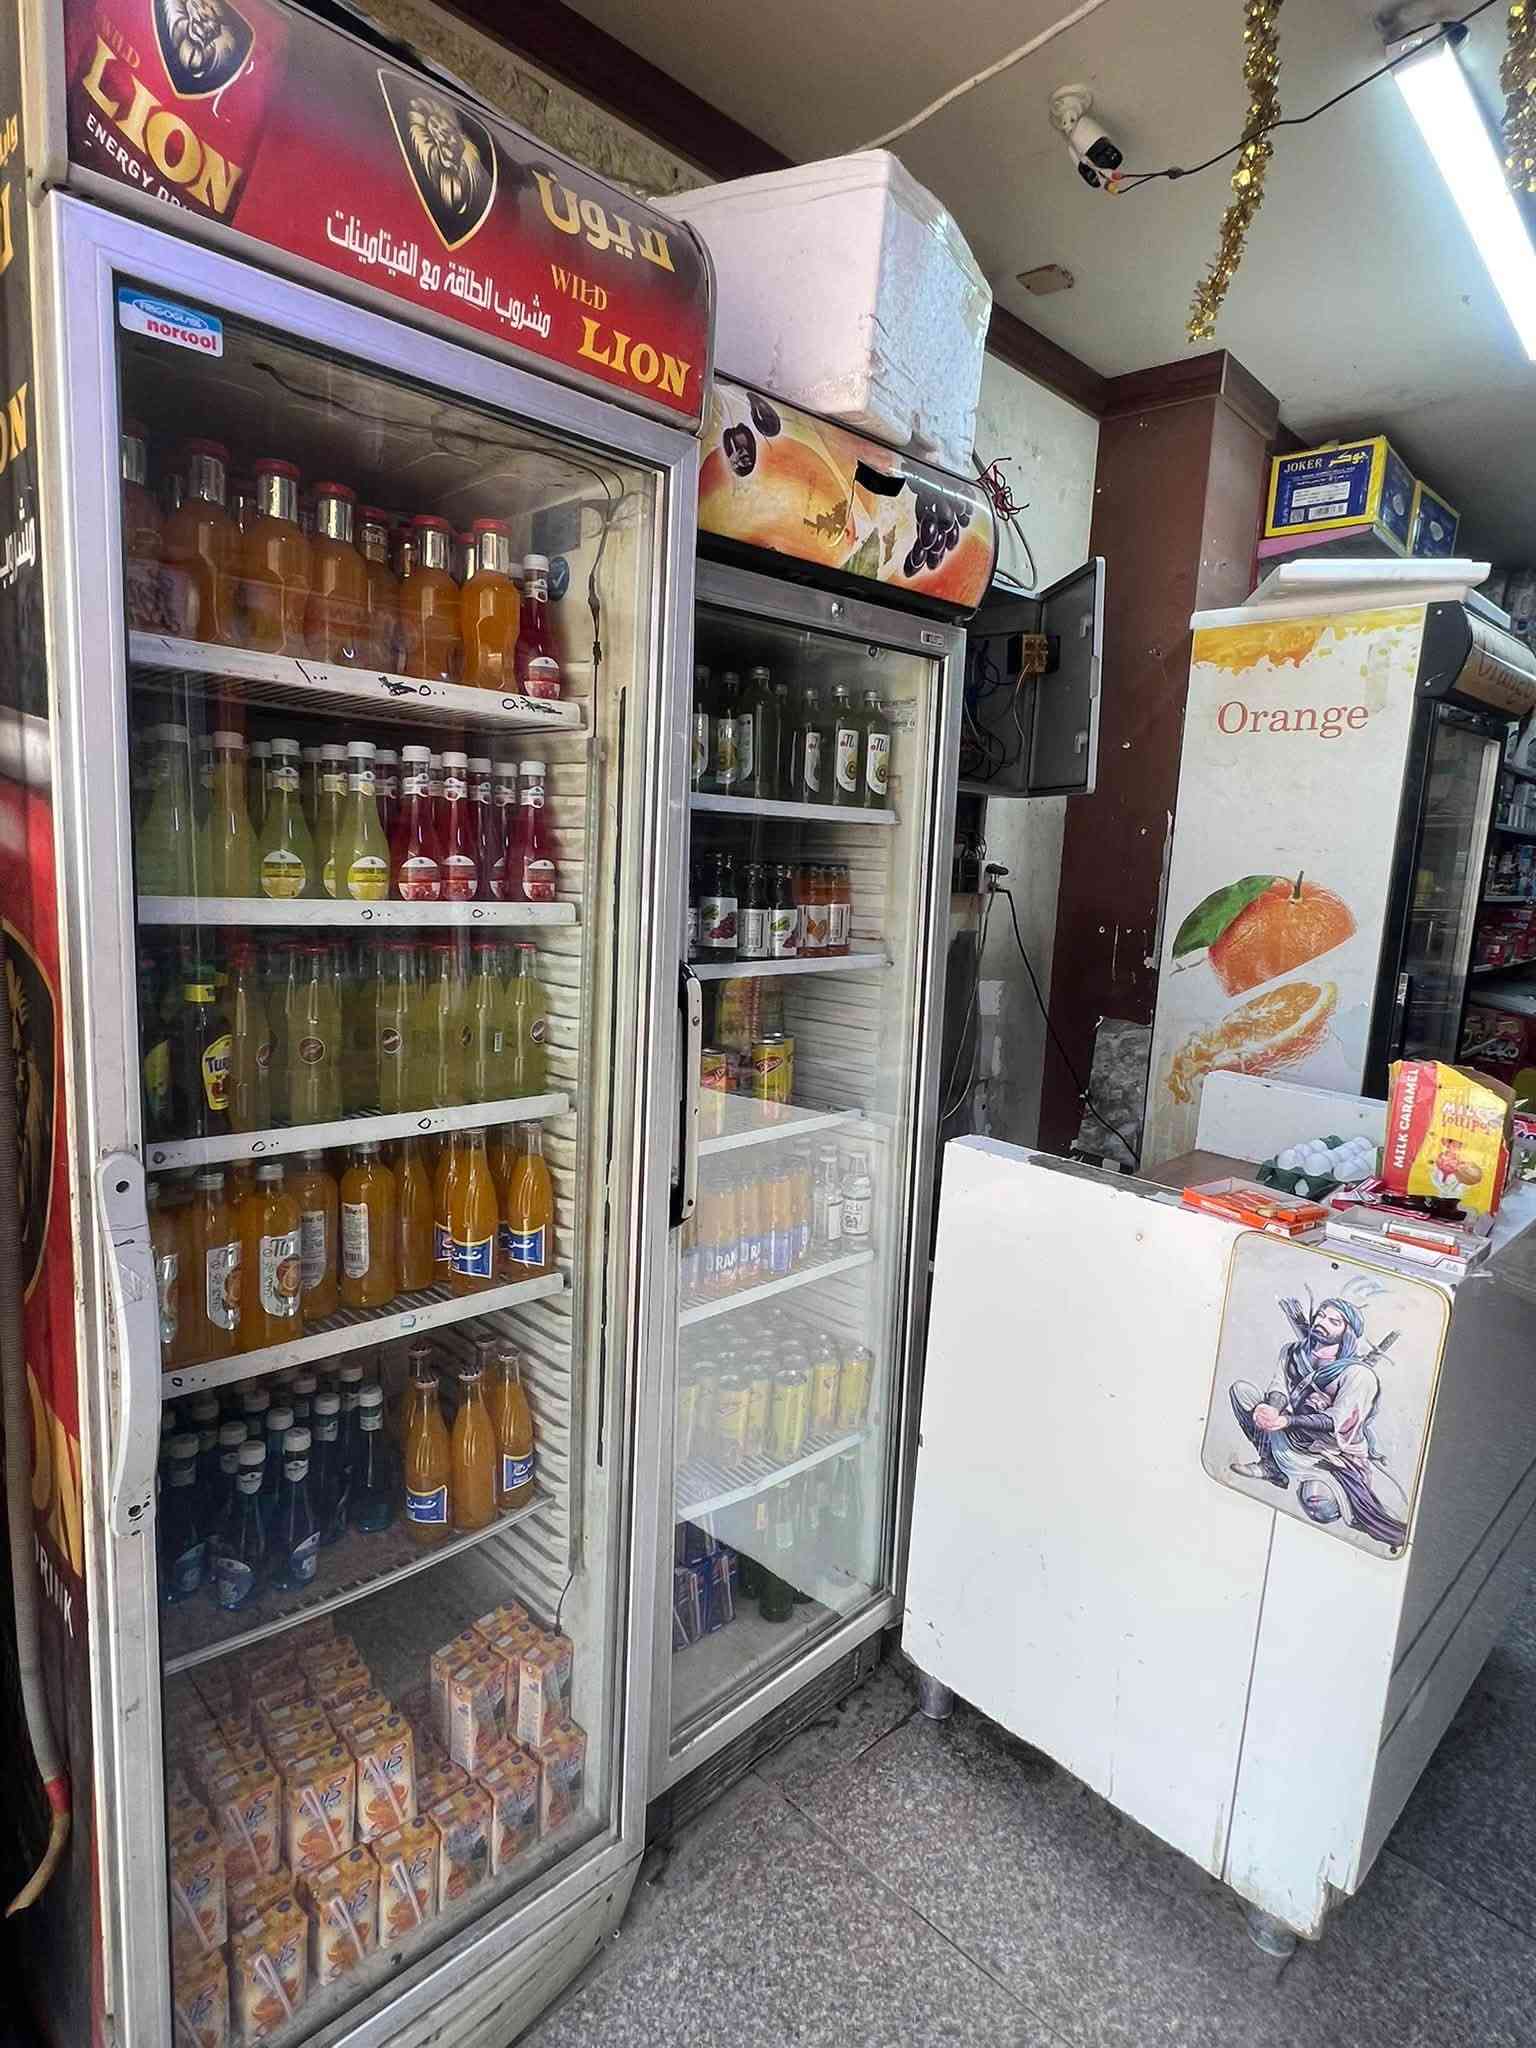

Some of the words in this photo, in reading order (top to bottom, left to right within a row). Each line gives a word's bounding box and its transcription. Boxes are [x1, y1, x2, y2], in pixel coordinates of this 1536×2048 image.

[82, 34, 243, 215] LION
[85, 112, 154, 189] ENERGY
[326, 208, 418, 279] الفيتامينات
[420, 258, 440, 291] مع
[443, 260, 492, 313] الطاقة
[550, 263, 608, 312] WILD
[146, 319, 217, 350] norcool
[494, 290, 552, 339] مشروب
[577, 316, 692, 398] LION
[1283, 458, 1323, 473] JOKER
[1217, 700, 1370, 739] Orange
[1400, 1067, 1420, 1131] CARAMEL
[1393, 1131, 1410, 1169] MILK
